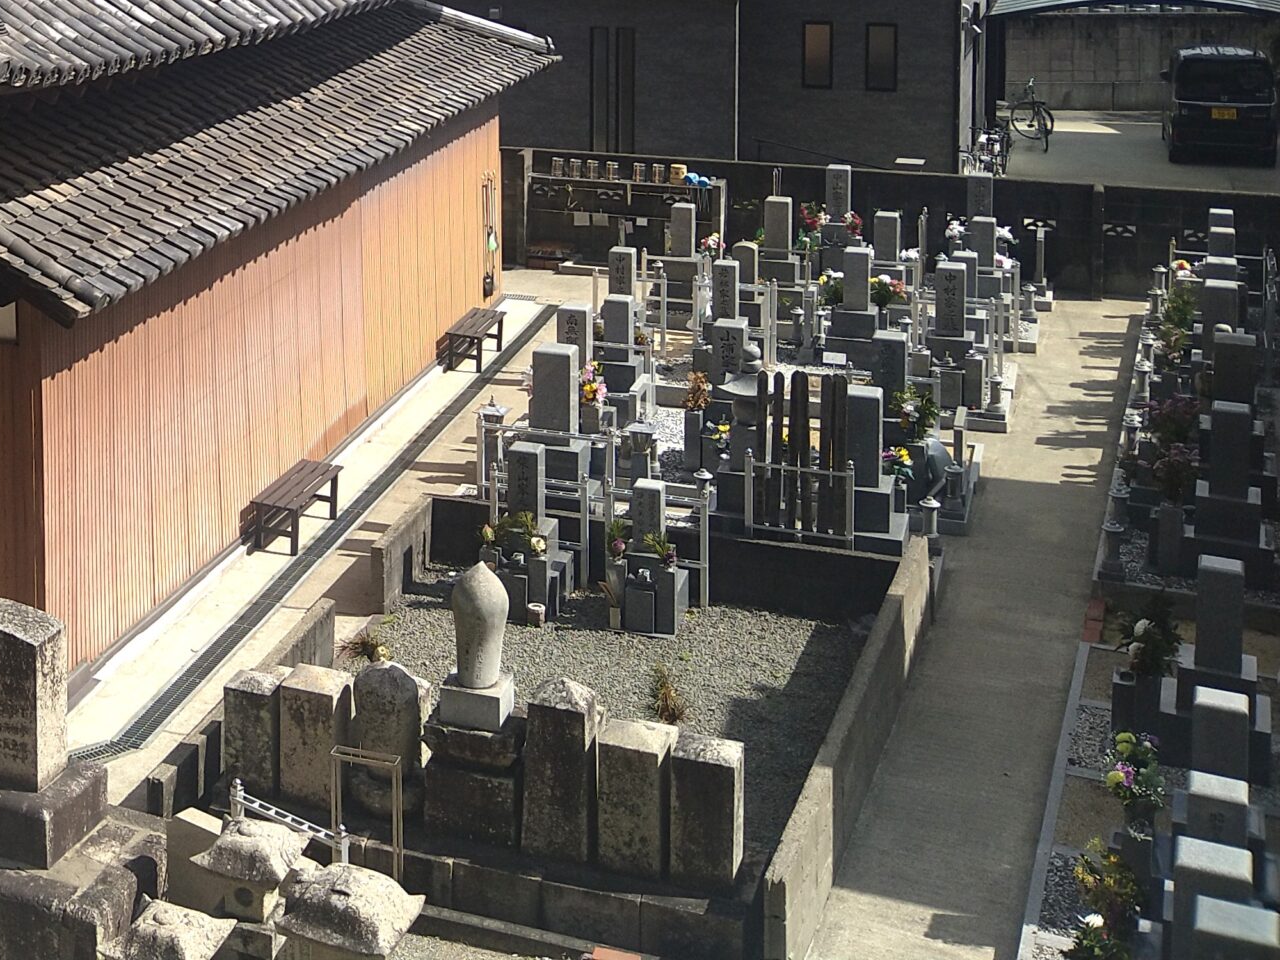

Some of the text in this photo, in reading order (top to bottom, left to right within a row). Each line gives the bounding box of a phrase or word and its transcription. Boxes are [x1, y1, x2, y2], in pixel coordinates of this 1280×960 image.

[943, 271, 960, 332] 中村家之墓
